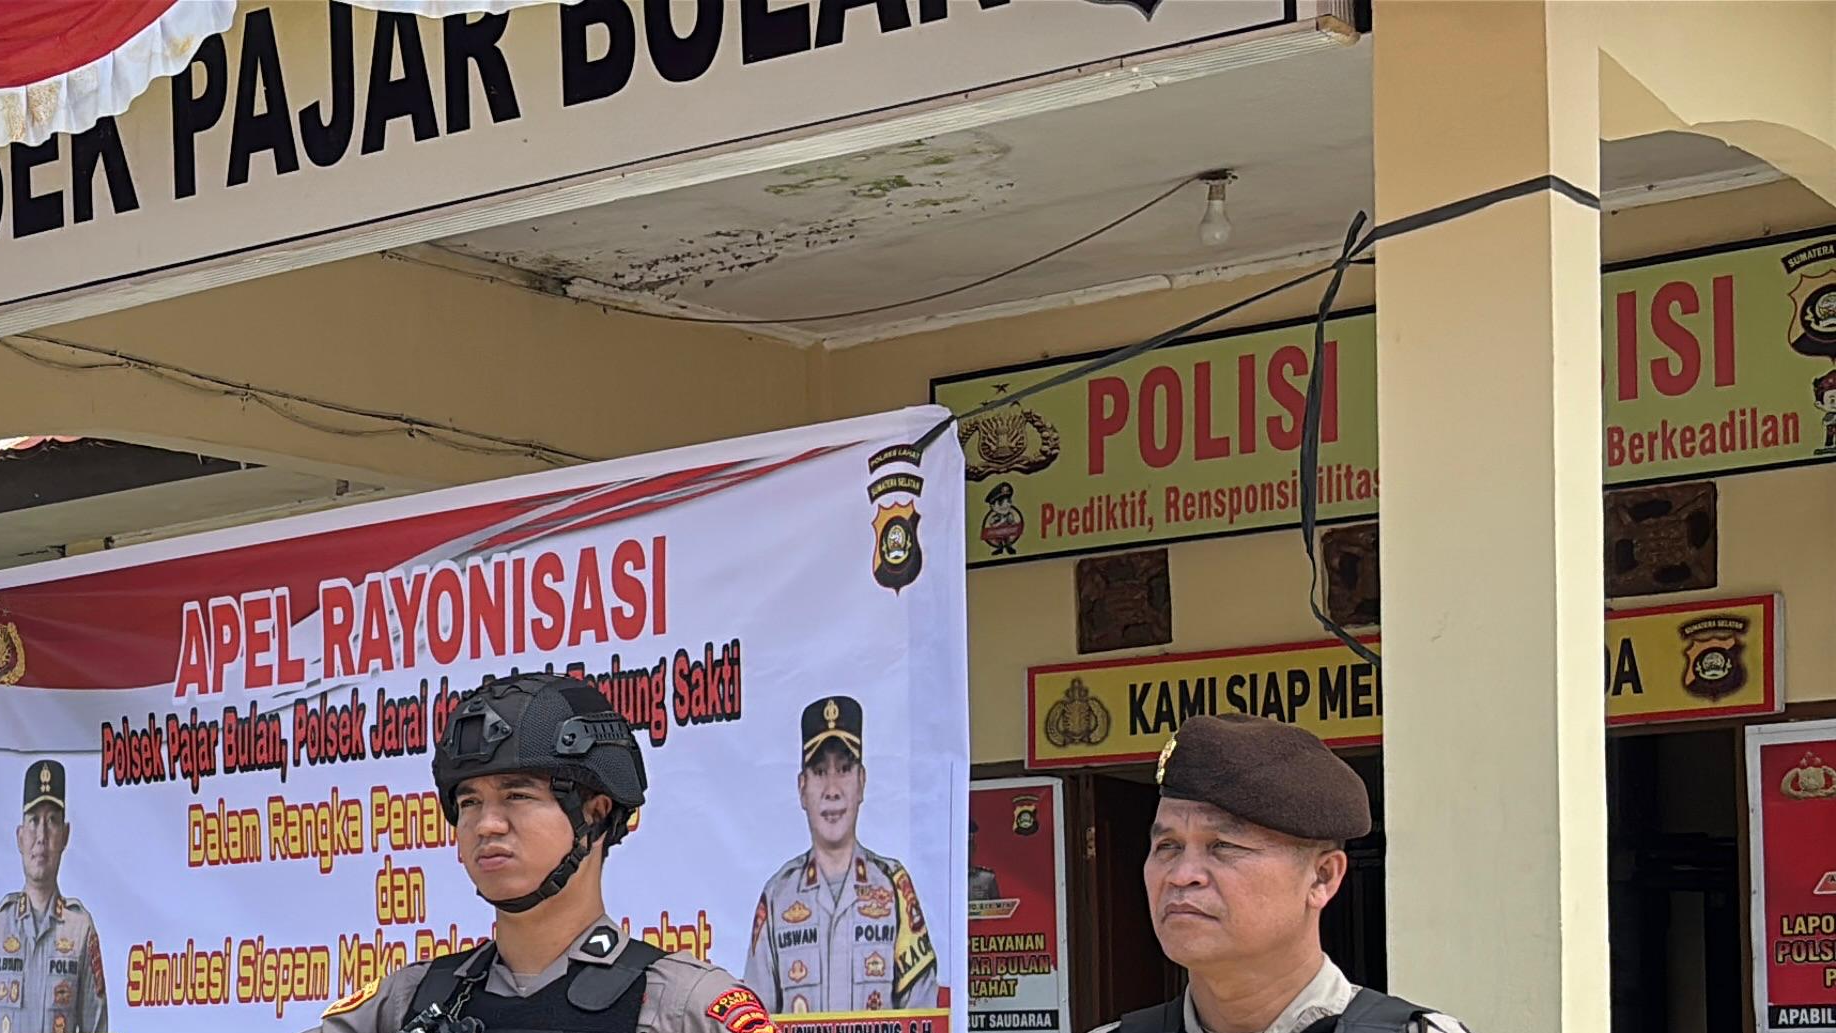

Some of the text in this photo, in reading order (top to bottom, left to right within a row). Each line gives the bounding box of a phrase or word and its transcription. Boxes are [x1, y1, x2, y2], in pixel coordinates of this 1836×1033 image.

[171, 0, 522, 200] PAJAR
[1602, 275, 1735, 401] ISI
[1088, 341, 1339, 476] POLISI
[1606, 406, 1800, 467] Berkeadilan
[1041, 489, 1155, 539] Prediktif,
[174, 535, 667, 699] APEL RAYONISASI
[101, 716, 166, 788] Polsek
[166, 707, 219, 795] Pajar
[223, 700, 288, 783] Bulan,
[292, 688, 366, 768] Polsek
[370, 678, 427, 760] Jarai
[673, 638, 741, 727] Sakti
[1129, 663, 1382, 736] KAMI SIAP ME
[188, 799, 262, 868] Dalam
[267, 786, 363, 874] Rangka
[375, 855, 426, 925] dan
[778, 925, 894, 949] LISWAN POLRI
[970, 933, 1046, 953] ELAYANAN
[1775, 940, 1836, 964] POLS
[1782, 915, 1836, 936] LAPO
[127, 936, 232, 1007] Simulasi
[236, 935, 330, 1019] Sispam
[970, 954, 1051, 976] AR BULAN
[970, 977, 1018, 997] LAHAT
[989, 1013, 1053, 1028] SAUDARAA
[1778, 1007, 1836, 1026] APABIL
